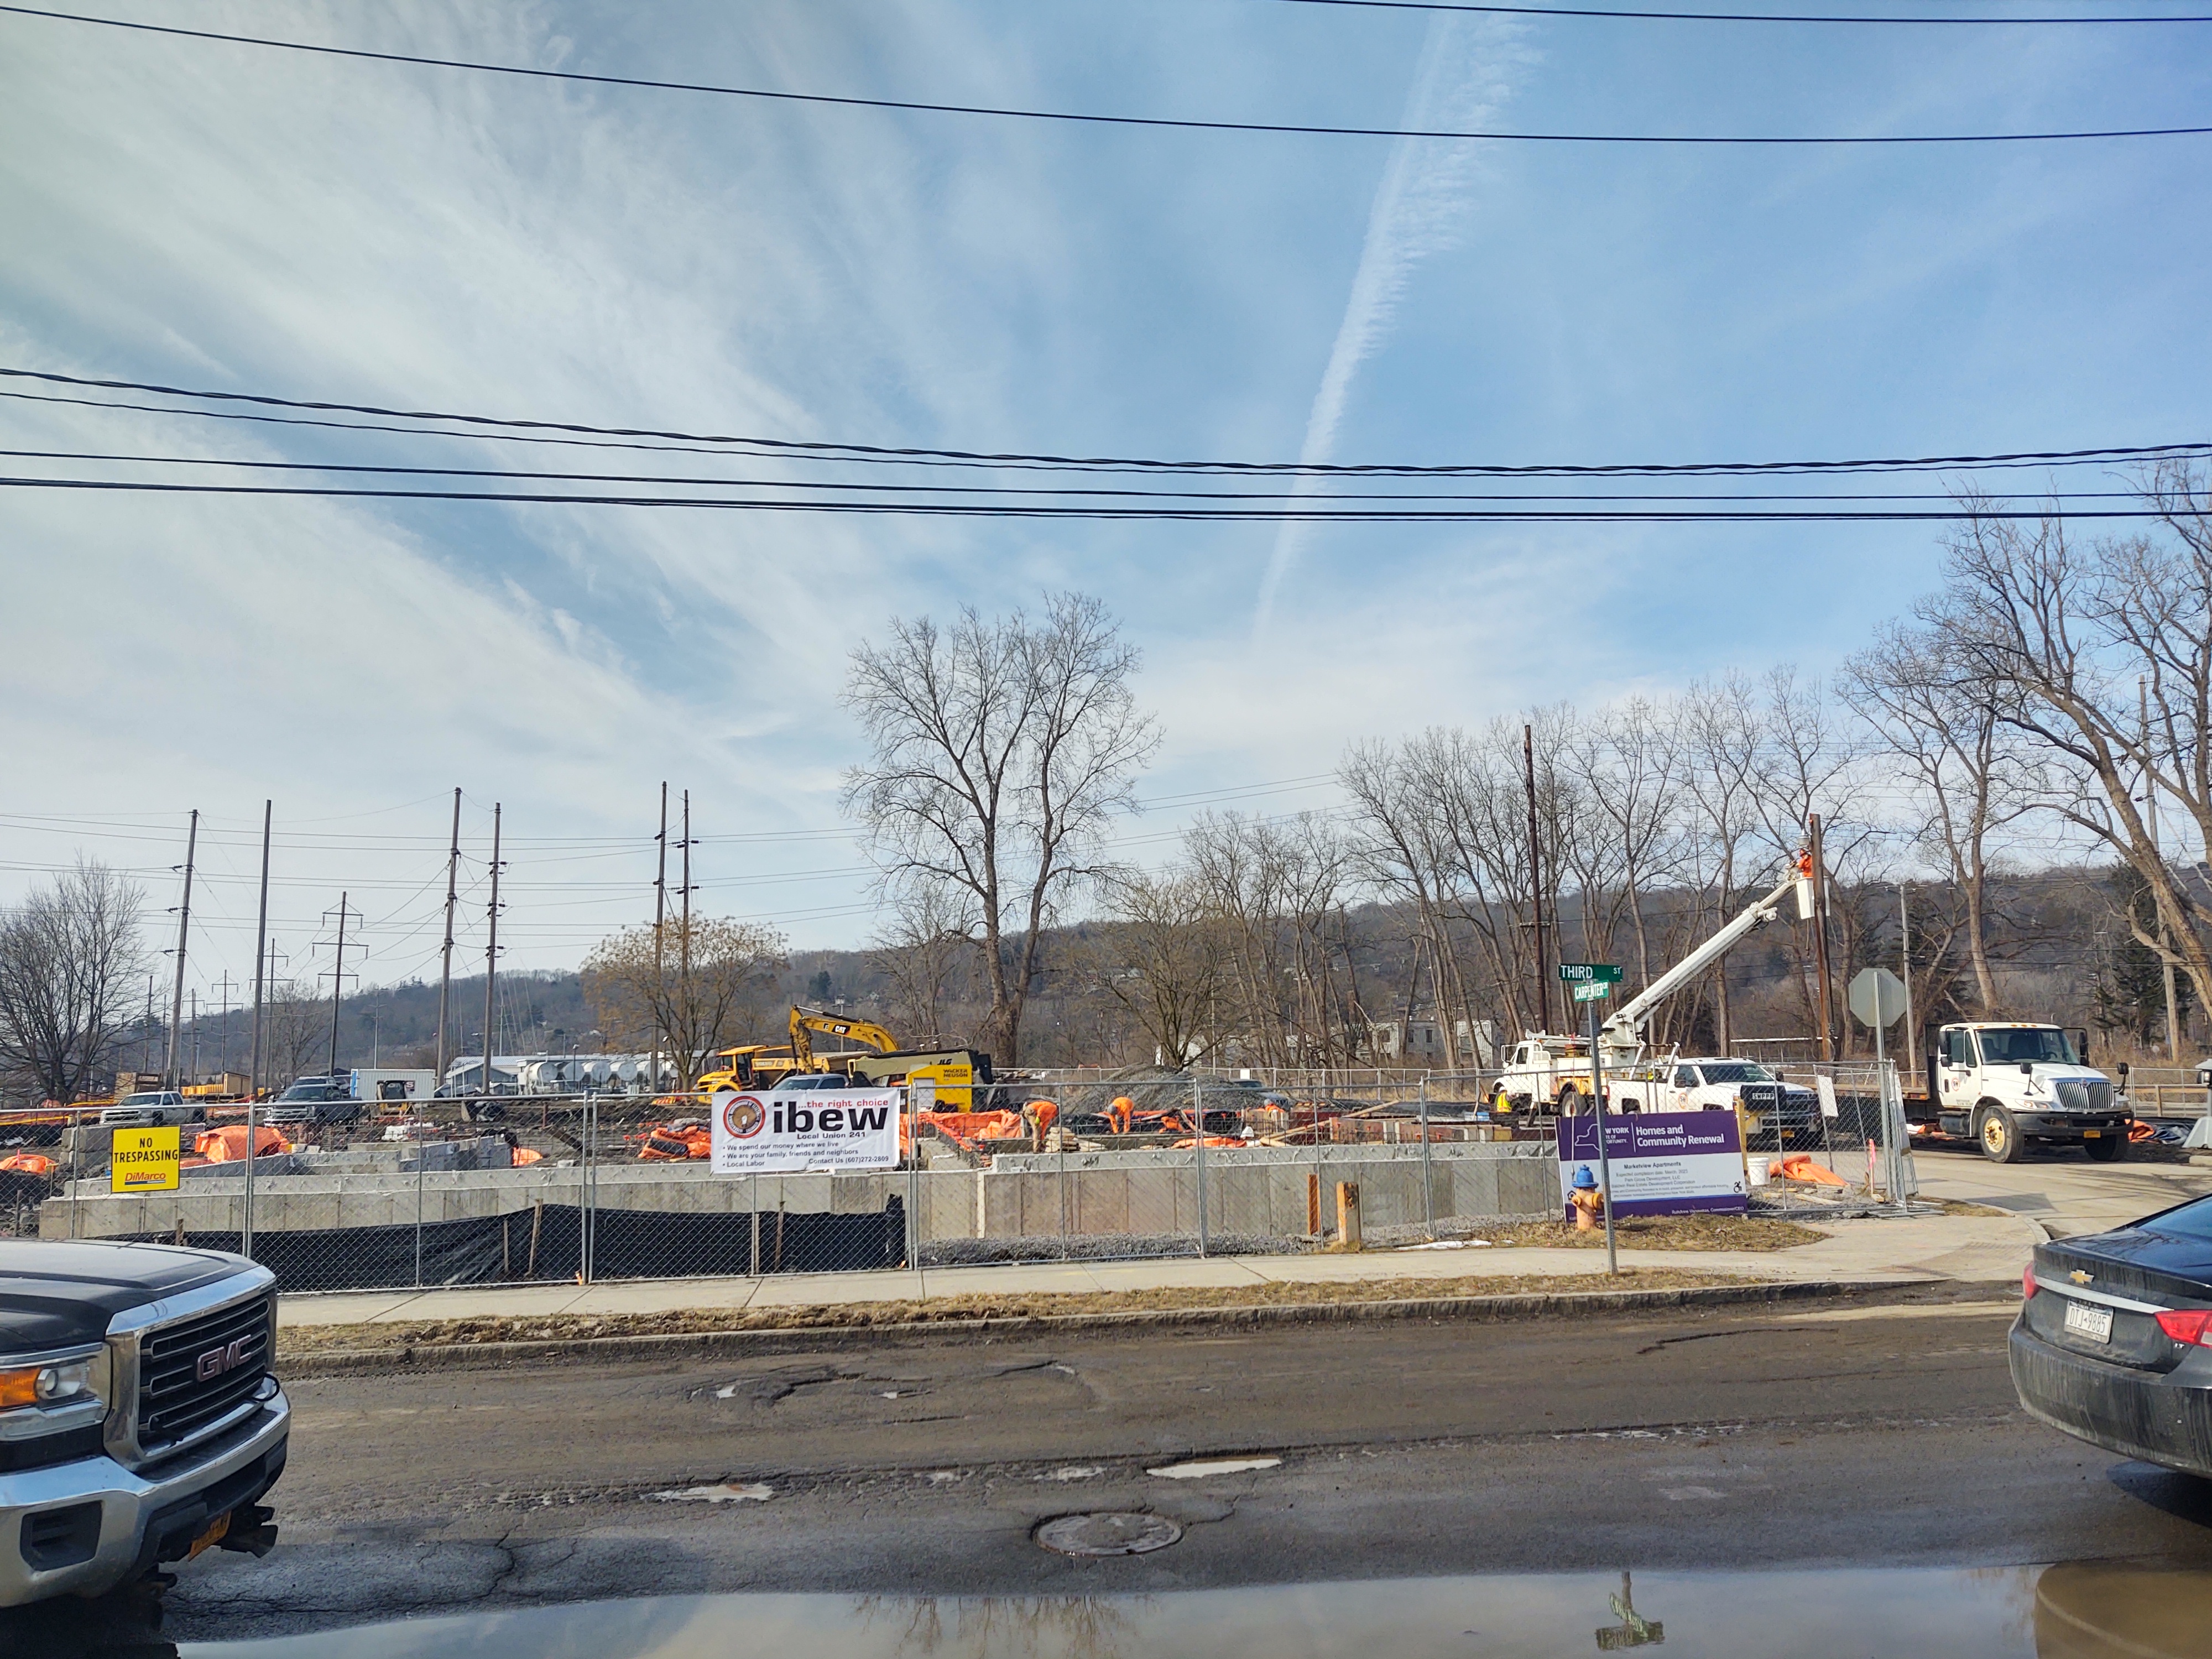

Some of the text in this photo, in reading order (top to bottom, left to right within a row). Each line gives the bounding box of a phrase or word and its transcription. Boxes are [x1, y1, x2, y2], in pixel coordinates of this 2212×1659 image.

[1561, 966, 1593, 978] THIRD
[1574, 983, 1604, 999] CARPENTER
[835, 1025, 846, 1034] CAT
[828, 1100, 852, 1108] right
[774, 1101, 888, 1133] ibew
[1636, 1124, 1683, 1135] Homes and
[139, 1138, 152, 1148] NO
[1637, 1134, 1724, 1148] Community Renewal
[114, 1149, 178, 1163] TRESPASSING
[125, 1172, 166, 1181] DiMarco
[2069, 1308, 2084, 1327] DTJ
[2088, 1313, 2107, 1333] 9885
[197, 1334, 252, 1382] GMC
